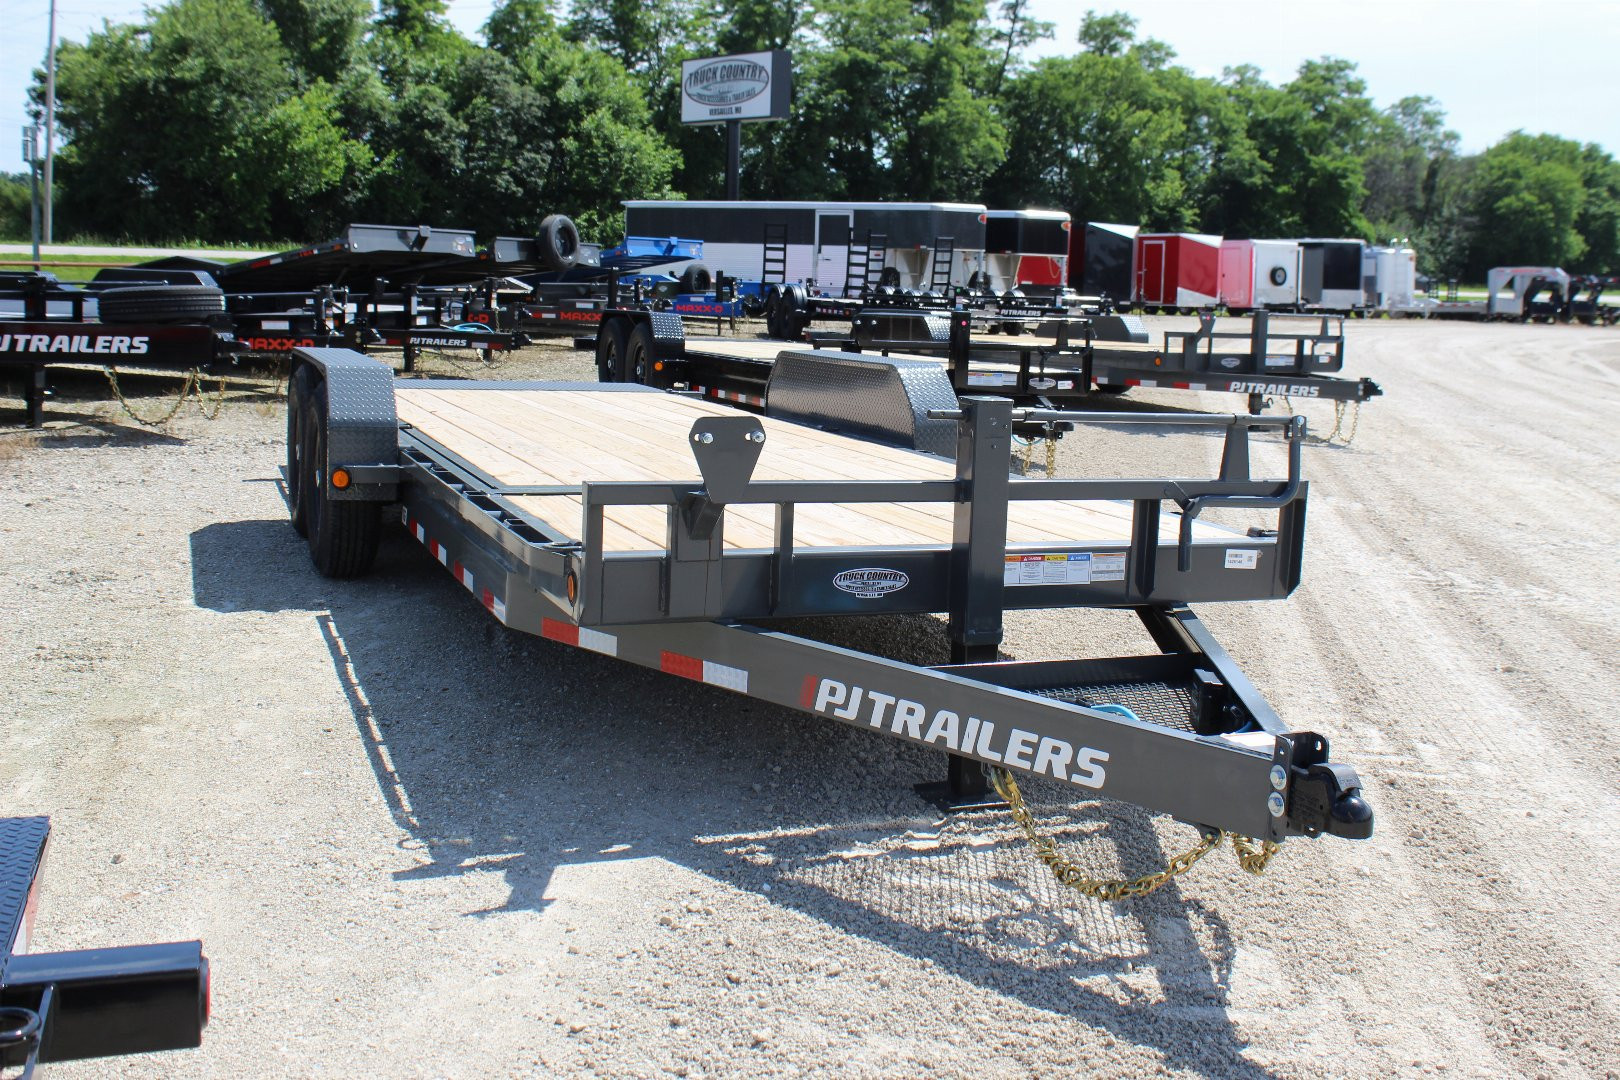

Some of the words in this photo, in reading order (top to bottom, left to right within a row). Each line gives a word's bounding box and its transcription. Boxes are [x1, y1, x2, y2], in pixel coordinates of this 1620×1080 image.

[688, 66, 719, 87] TRUCK
[720, 63, 765, 80] COUNTRY
[675, 304, 724, 313] MAXX-D
[1009, 309, 1041, 317] TRAILERS
[560, 311, 602, 321] MAXX
[0, 334, 12, 352] J
[13, 334, 149, 354] TRAILERS
[421, 338, 467, 346] TRAILERS
[1229, 381, 1246, 393] PJ
[1246, 382, 1320, 397] TRAILERS
[839, 571, 866, 582] TRUCK
[866, 571, 903, 581] COUNTRY
[814, 678, 864, 721] PJ
[867, 690, 1110, 789] TRAILERS
